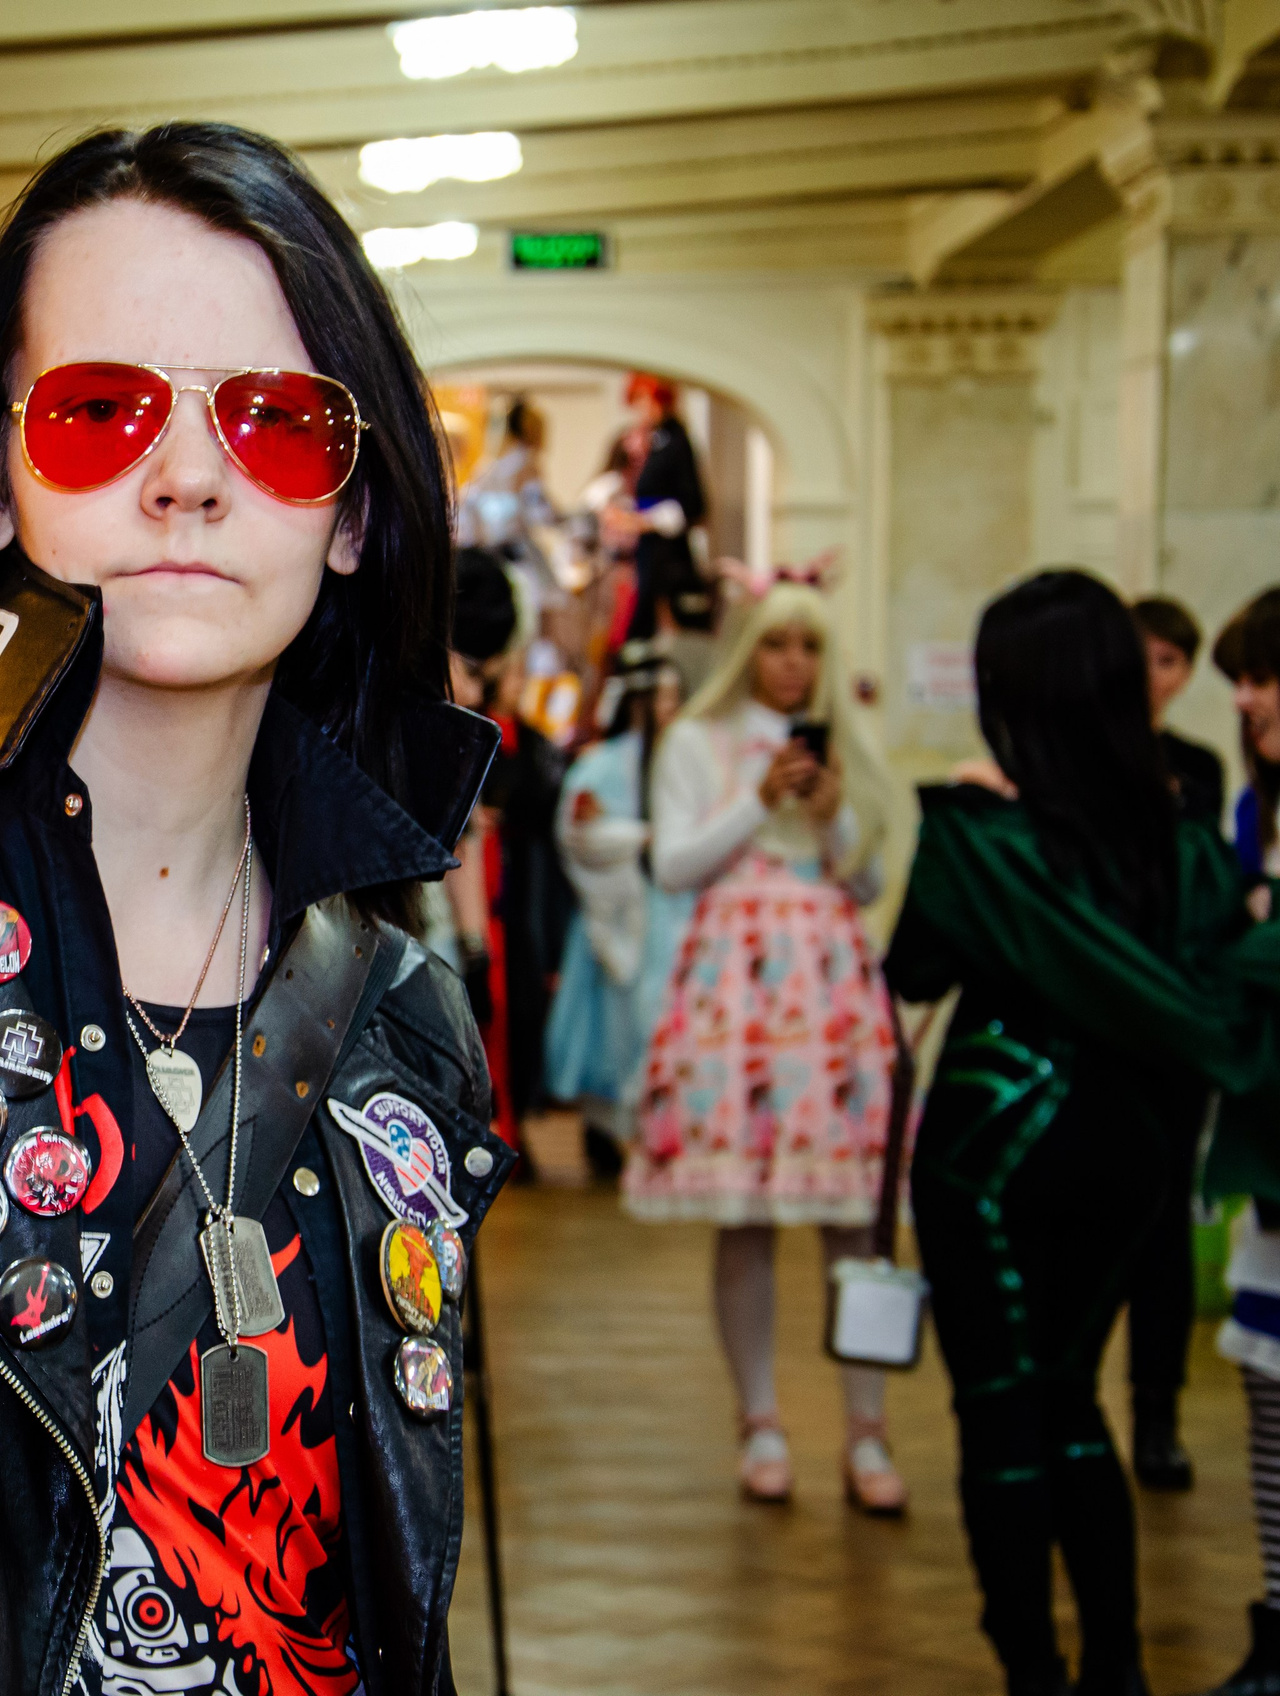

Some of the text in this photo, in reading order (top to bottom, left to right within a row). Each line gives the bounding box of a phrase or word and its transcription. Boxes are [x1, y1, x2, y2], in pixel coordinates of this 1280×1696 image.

[374, 1100, 446, 1174] SUPPORT YOUR
[375, 1171, 408, 1215] NIGHT
